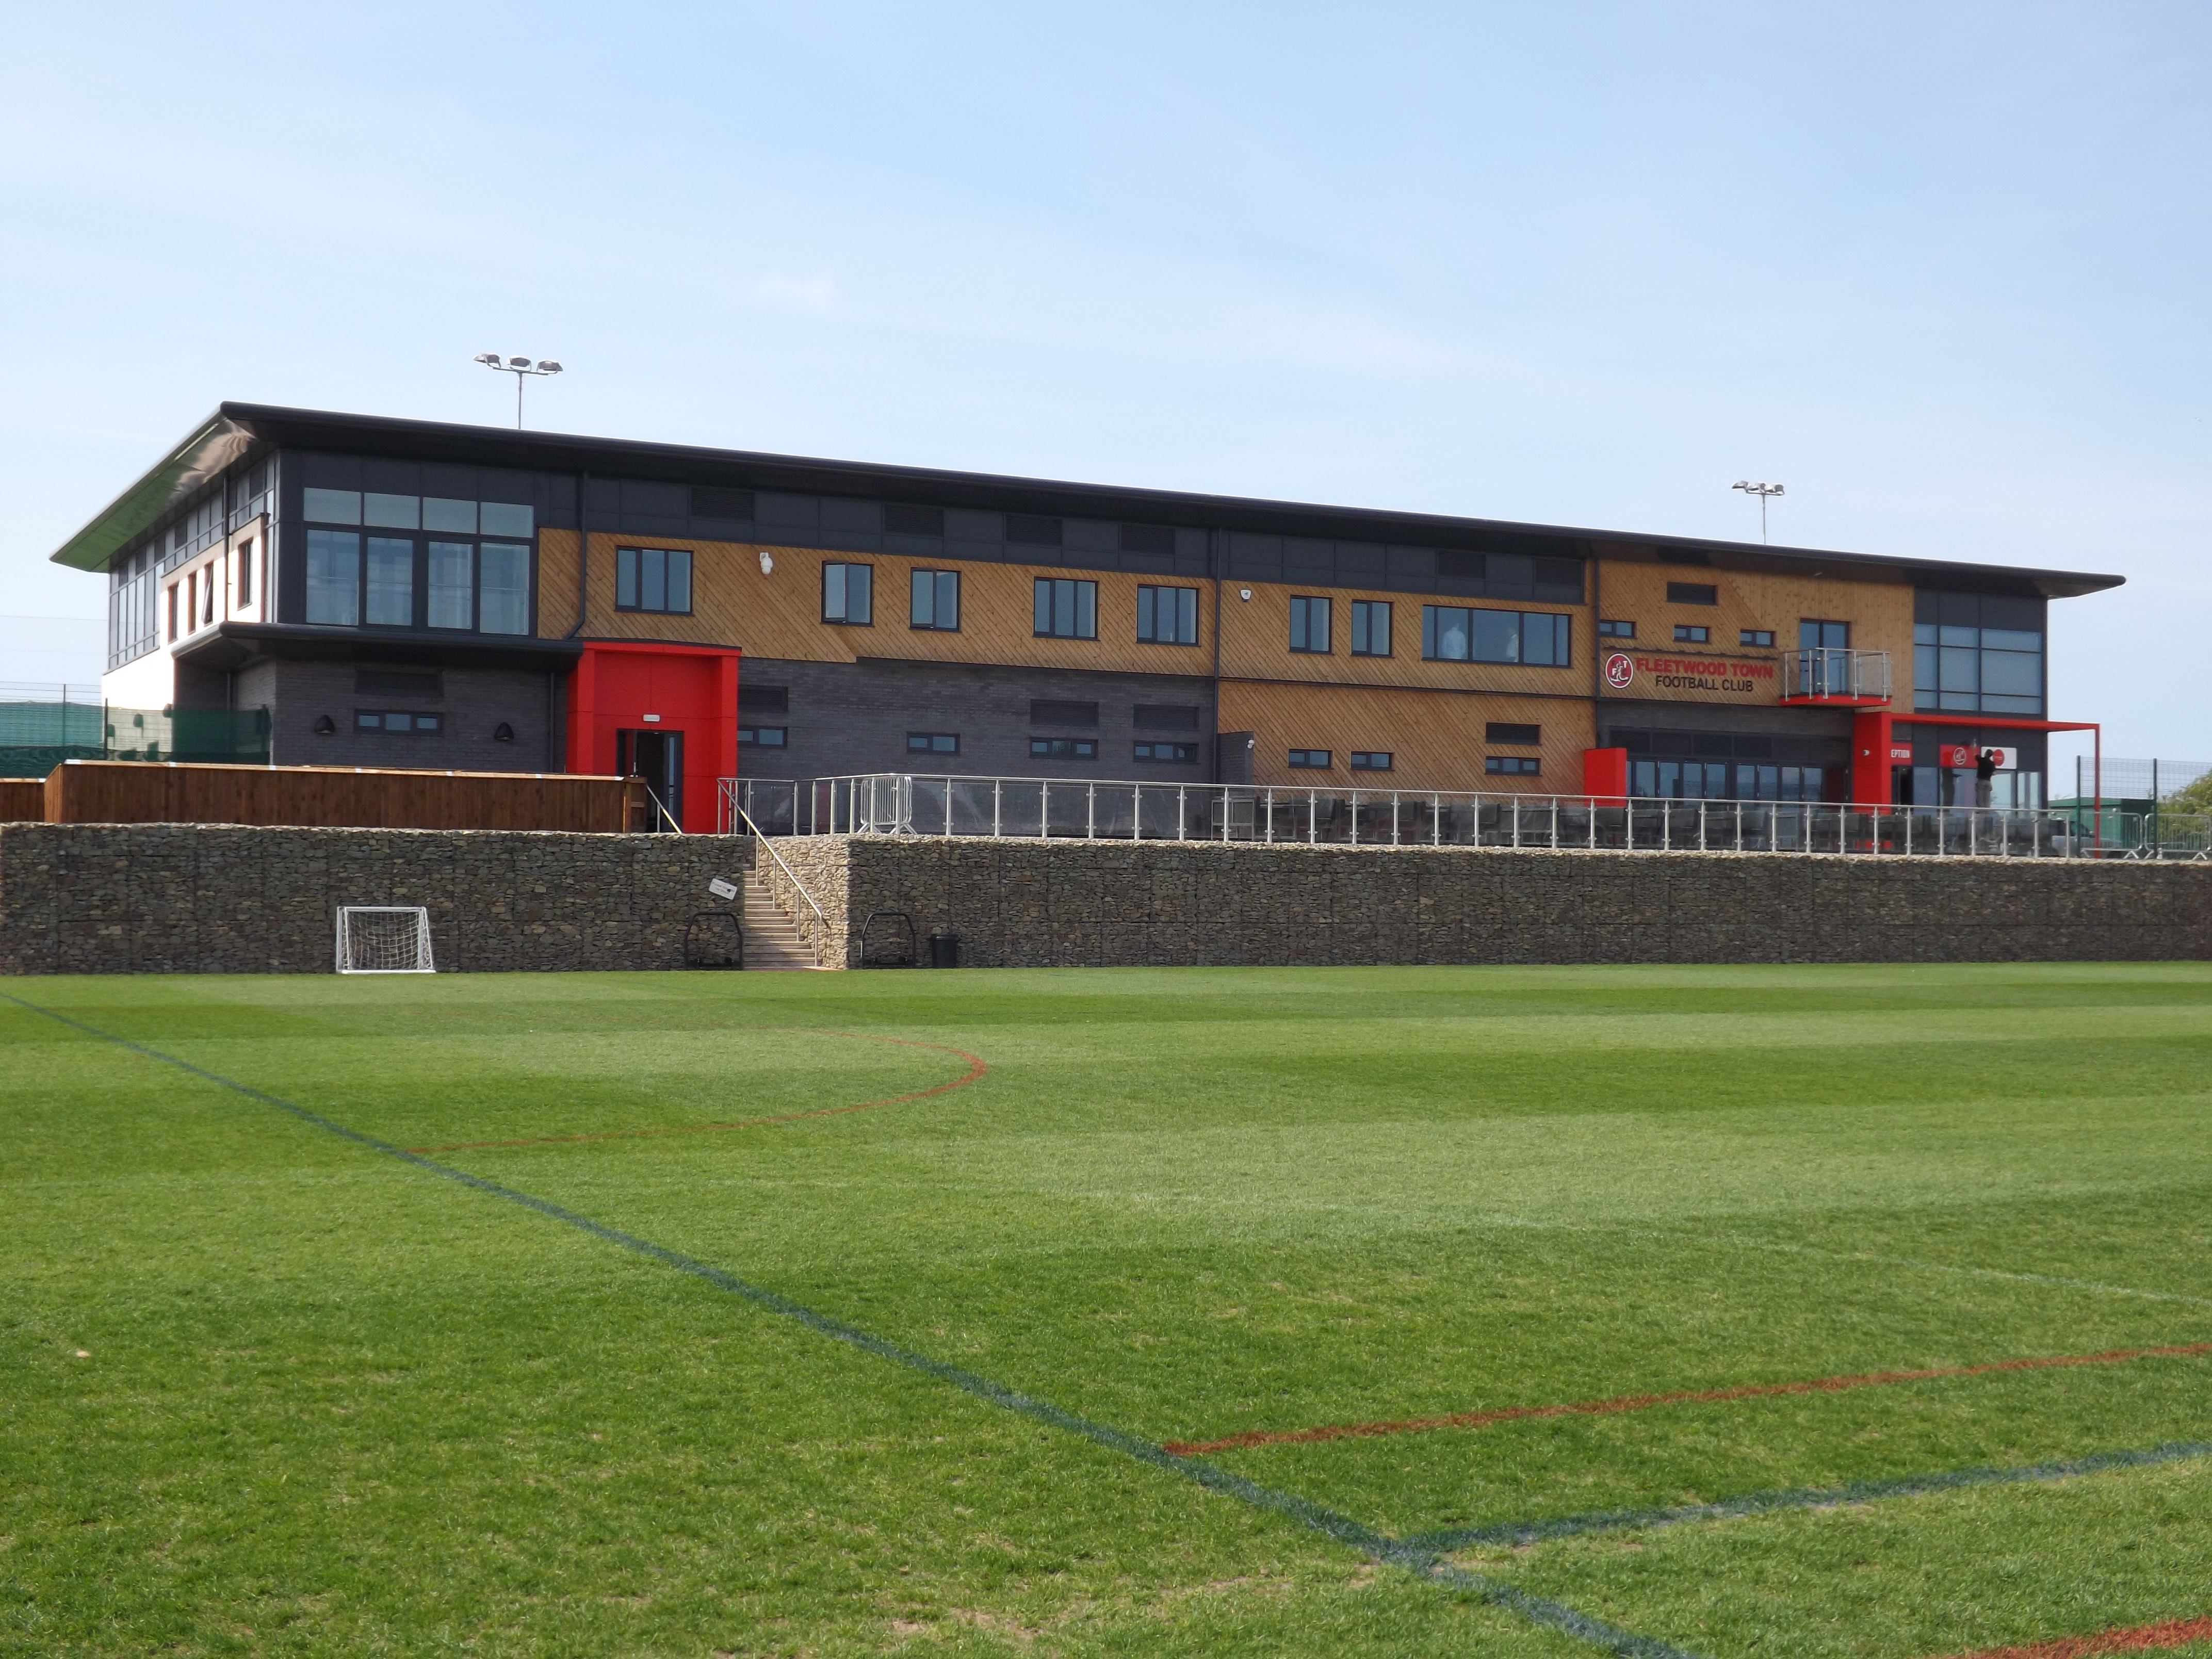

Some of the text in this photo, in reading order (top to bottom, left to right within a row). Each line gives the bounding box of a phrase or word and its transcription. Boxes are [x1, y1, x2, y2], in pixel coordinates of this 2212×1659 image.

[1635, 657, 1774, 679] FLEETWOOD TOWN
[1655, 675, 1753, 692] FOOTBALL CLUB
[1891, 749, 1910, 758] EPTION
